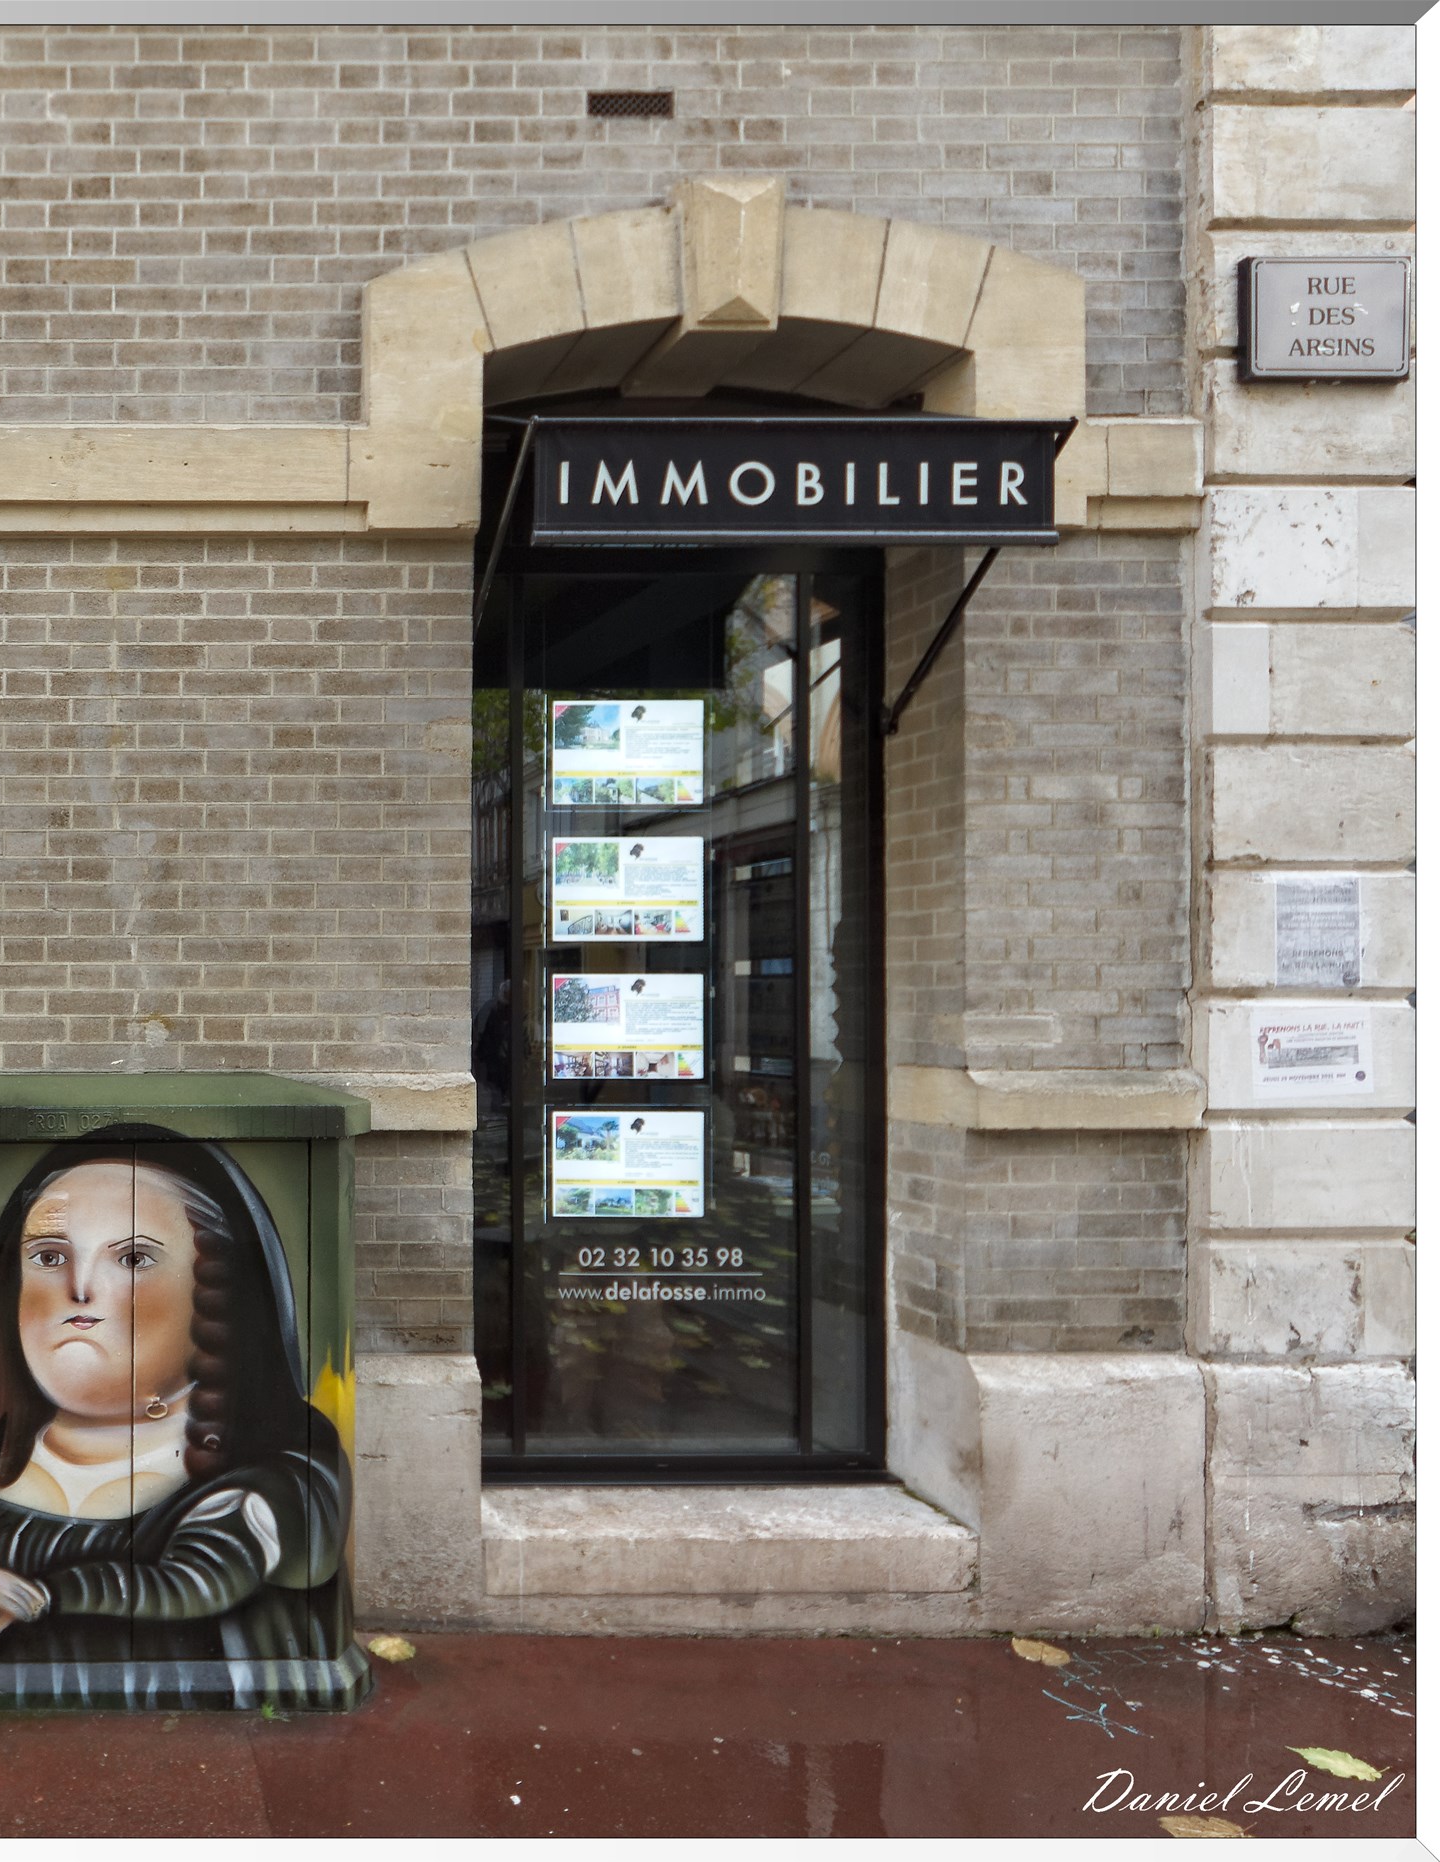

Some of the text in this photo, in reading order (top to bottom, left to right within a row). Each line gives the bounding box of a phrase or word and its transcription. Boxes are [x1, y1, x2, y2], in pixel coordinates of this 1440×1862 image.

[1307, 277, 1356, 295] RUE
[1308, 307, 1356, 326] DES
[1288, 338, 1376, 357] ARSINS
[559, 459, 1029, 506] IMMOBILIER
[578, 1247, 743, 1267] 02 32 10 35 98
[558, 1281, 767, 1302] www.delafosse.immo
